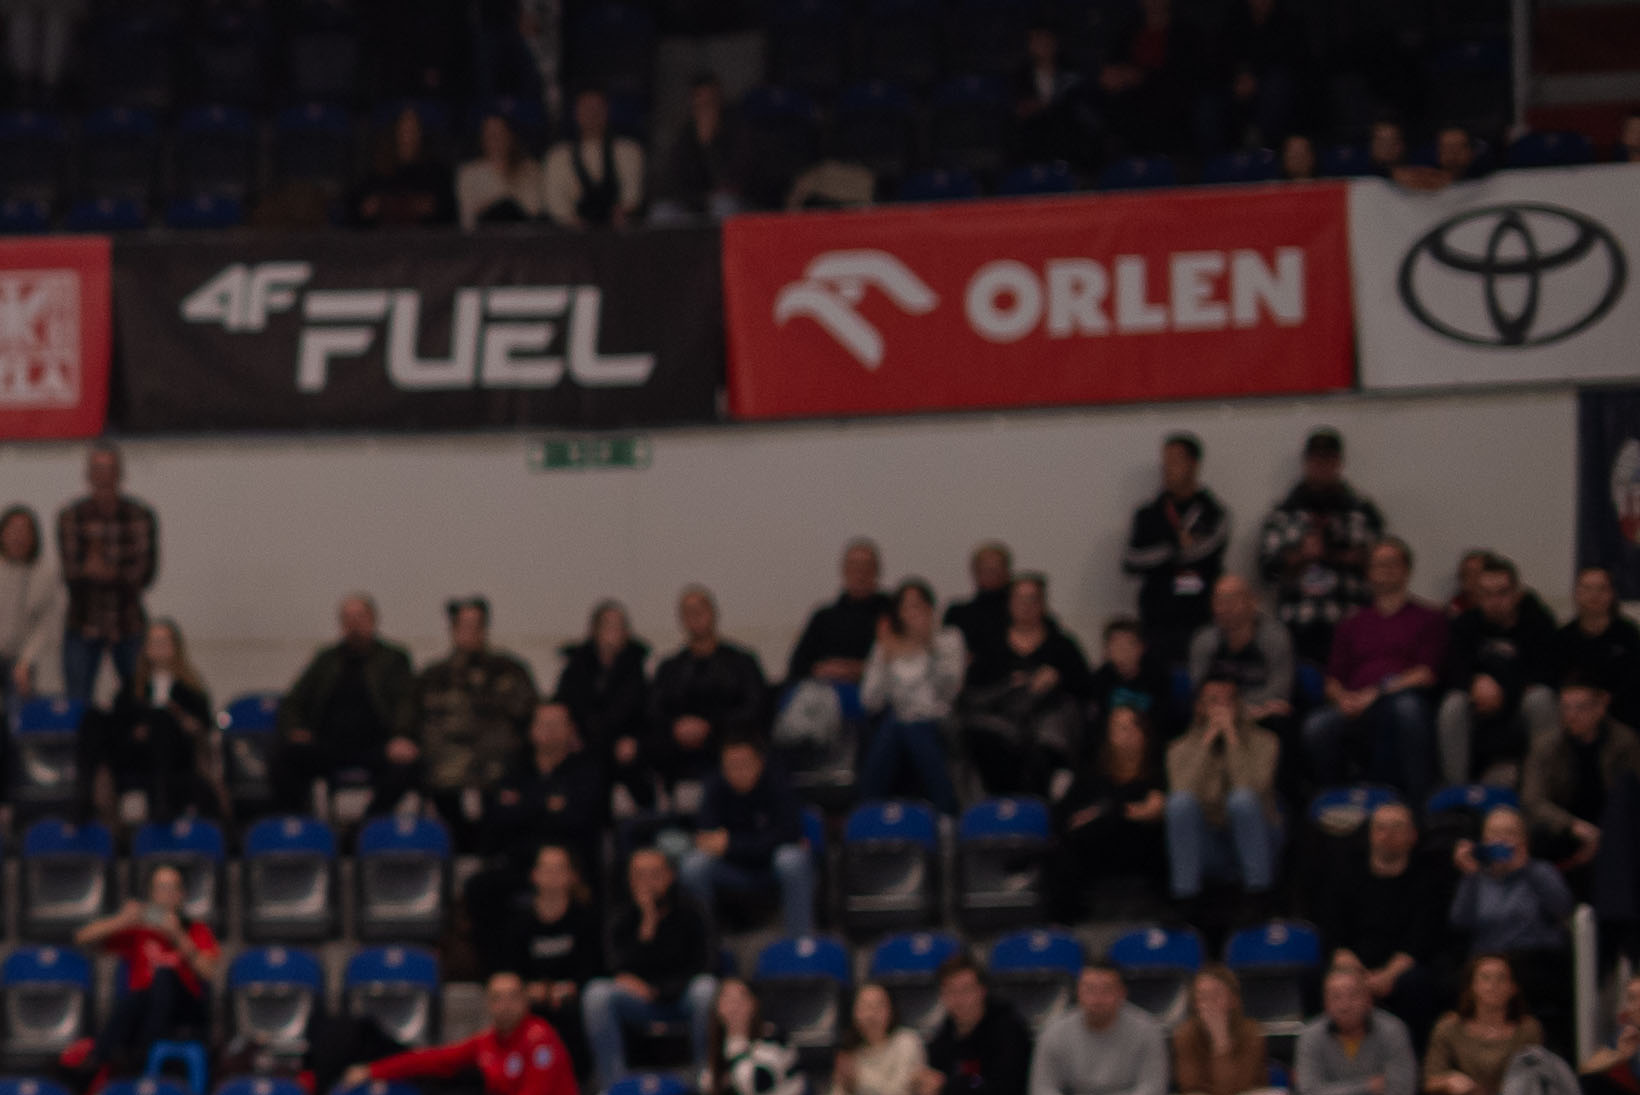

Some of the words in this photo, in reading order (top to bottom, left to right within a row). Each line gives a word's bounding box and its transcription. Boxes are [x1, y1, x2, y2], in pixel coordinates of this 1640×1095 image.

[180, 260, 314, 333] 4F
[295, 285, 658, 393] FUEL
[965, 248, 1307, 345] ORLEN
